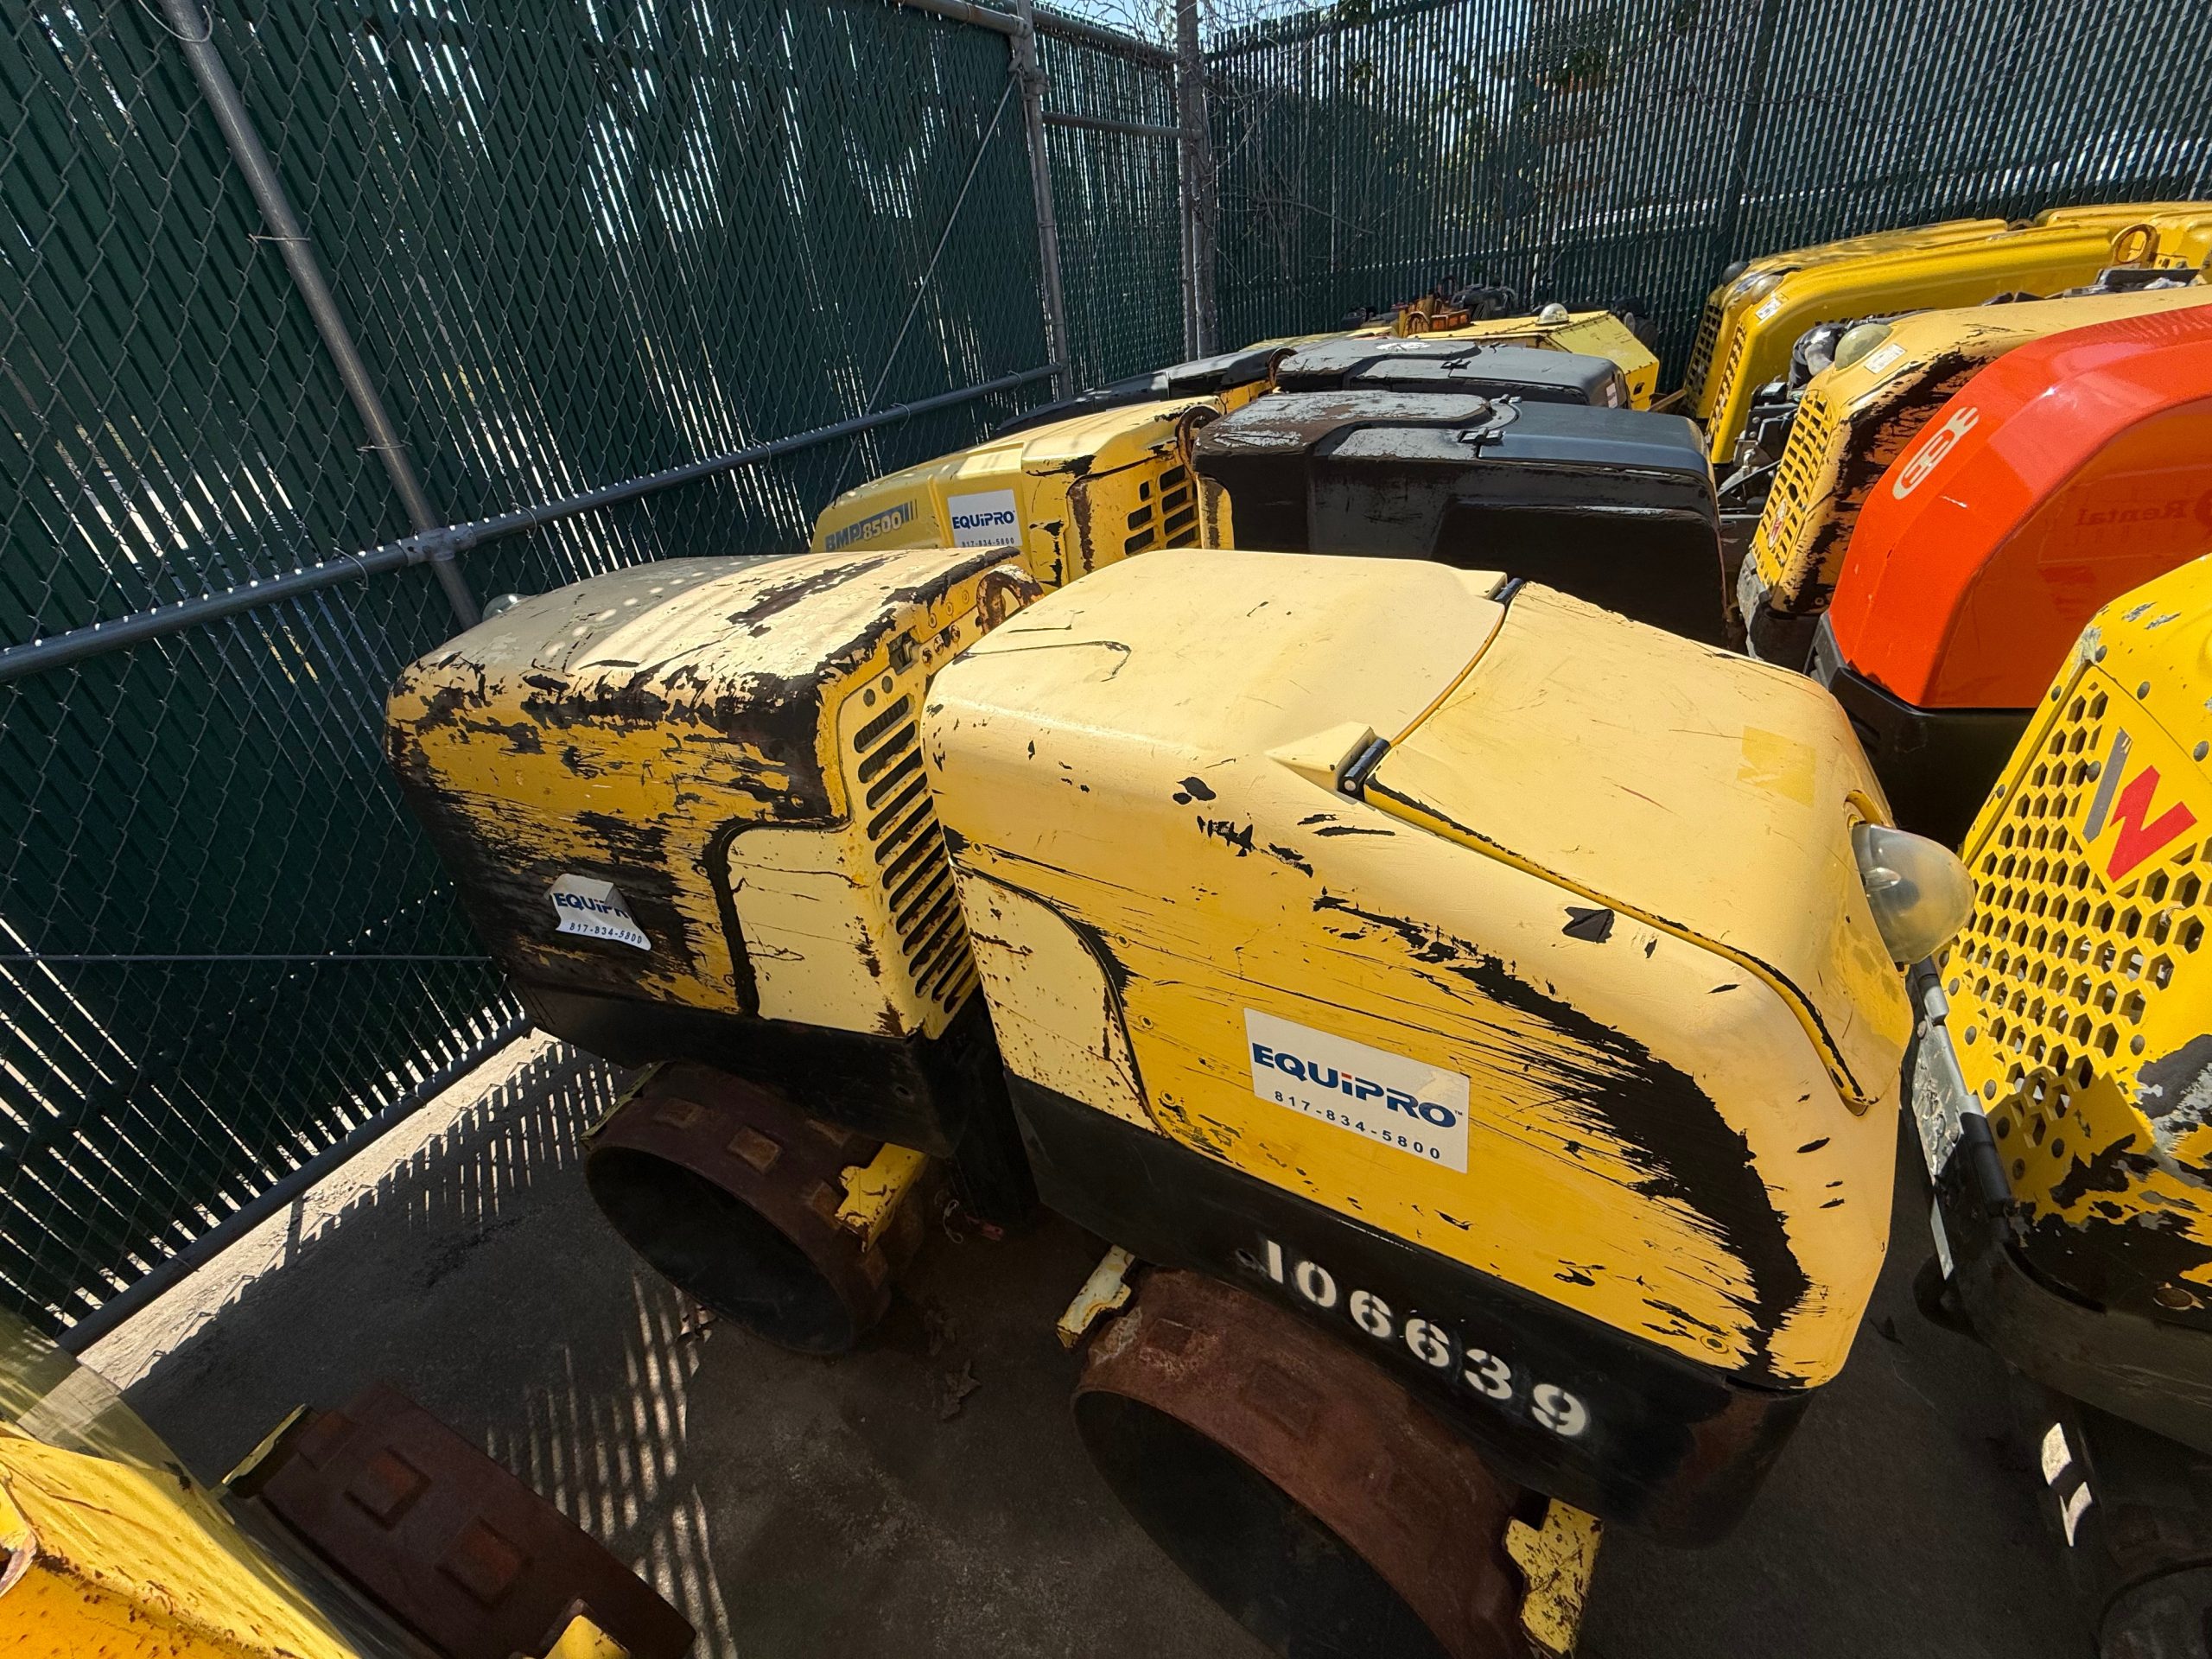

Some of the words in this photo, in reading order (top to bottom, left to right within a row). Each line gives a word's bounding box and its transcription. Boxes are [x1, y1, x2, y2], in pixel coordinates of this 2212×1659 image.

[962, 537, 1014, 547] 817-834-5800
[569, 922, 642, 944] 817-834-5800
[1274, 1090, 1440, 1160] 817-834-5800
[1267, 1239, 1589, 1436] 106639
